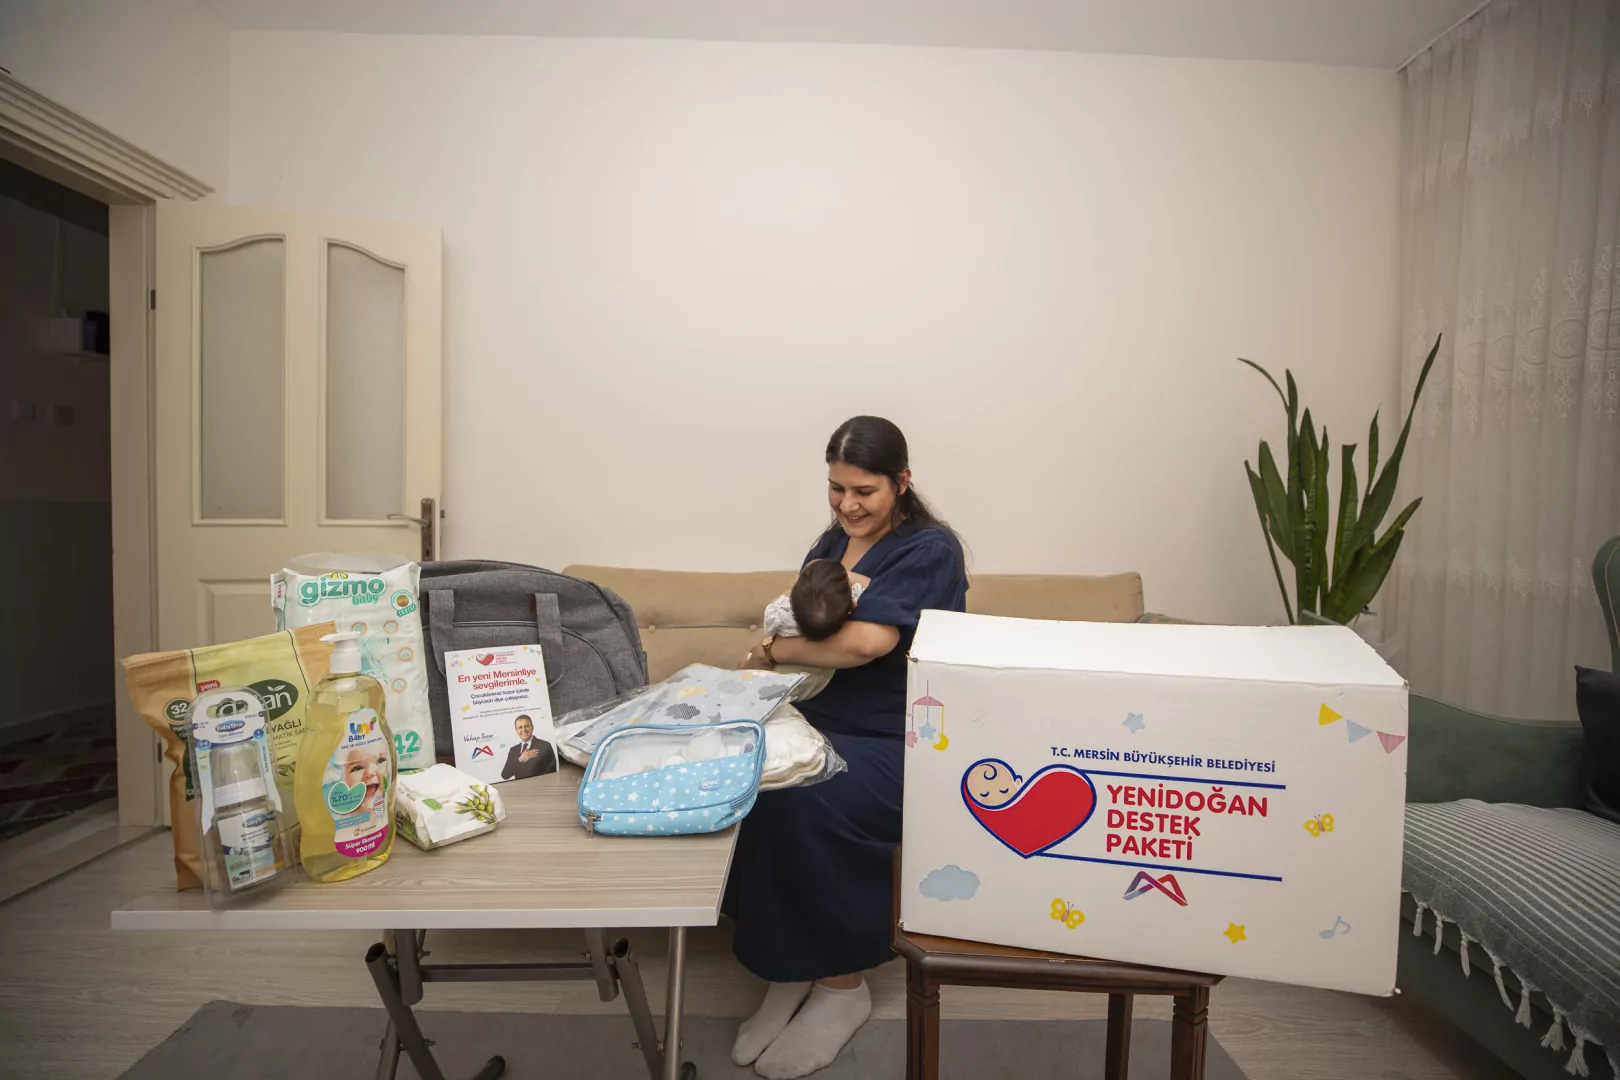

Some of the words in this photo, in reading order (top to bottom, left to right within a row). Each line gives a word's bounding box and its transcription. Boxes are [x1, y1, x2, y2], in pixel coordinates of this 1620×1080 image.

[300, 577, 385, 605] gizmo
[352, 593, 380, 606] baby
[458, 674, 470, 683] En
[472, 672, 491, 682] yeni
[493, 668, 536, 679] Mersinliye
[473, 678, 527, 690] sevgilerimle.
[170, 702, 187, 714] 32
[394, 731, 420, 754] 42
[400, 753, 413, 761] pcs
[1051, 747, 1071, 758] T.C.
[1073, 748, 1120, 762] MERSİN
[1124, 750, 1203, 768] BÜYÜKŞEHİR
[1206, 757, 1276, 773] BELEDİYESİ
[1106, 783, 1268, 817] YENİDOĞAN
[1107, 809, 1201, 837] DESTEK
[1106, 833, 1193, 861] PAKETİ
